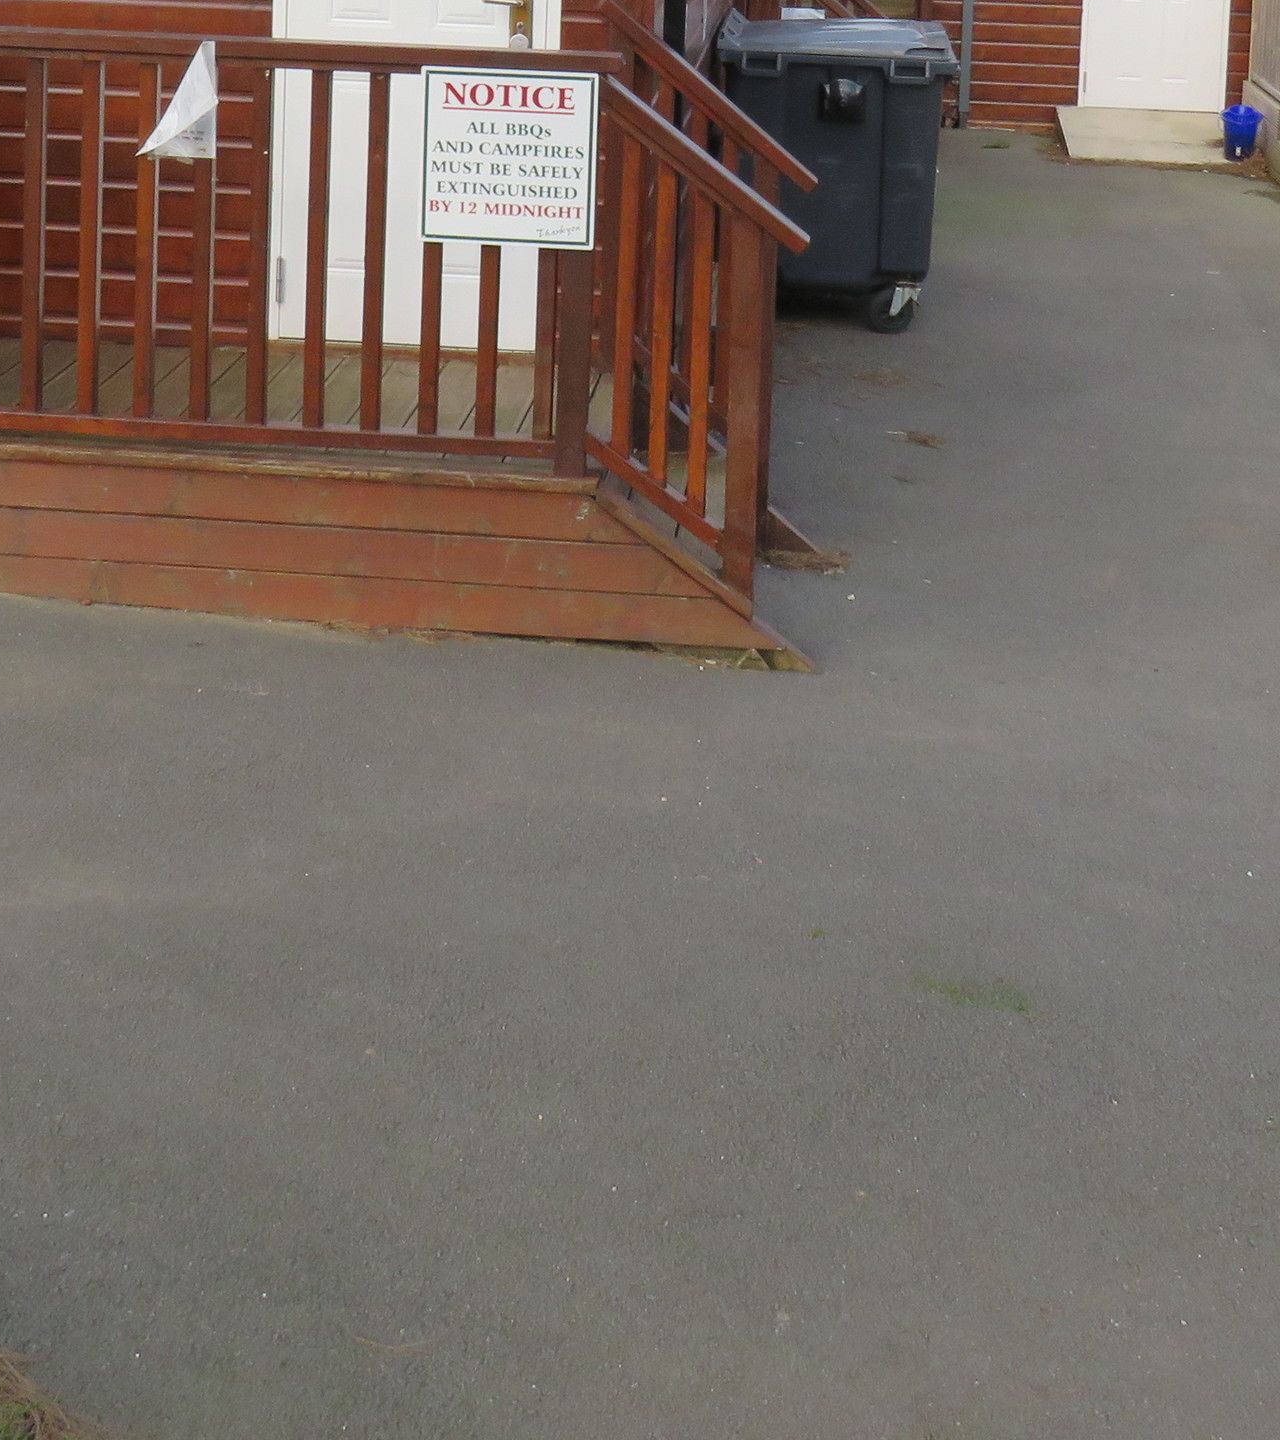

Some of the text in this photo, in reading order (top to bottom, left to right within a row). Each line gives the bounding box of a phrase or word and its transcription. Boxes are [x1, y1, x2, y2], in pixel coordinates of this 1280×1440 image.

[442, 81, 576, 111] NOTICE
[466, 120, 552, 140] ALL BBQs
[432, 140, 585, 160] AND CAMPFIRES
[431, 160, 585, 180] MUST BE SAFELY
[436, 180, 578, 200] EXTINGUISHED
[428, 199, 585, 220] BY 12 MIDNIGHT
